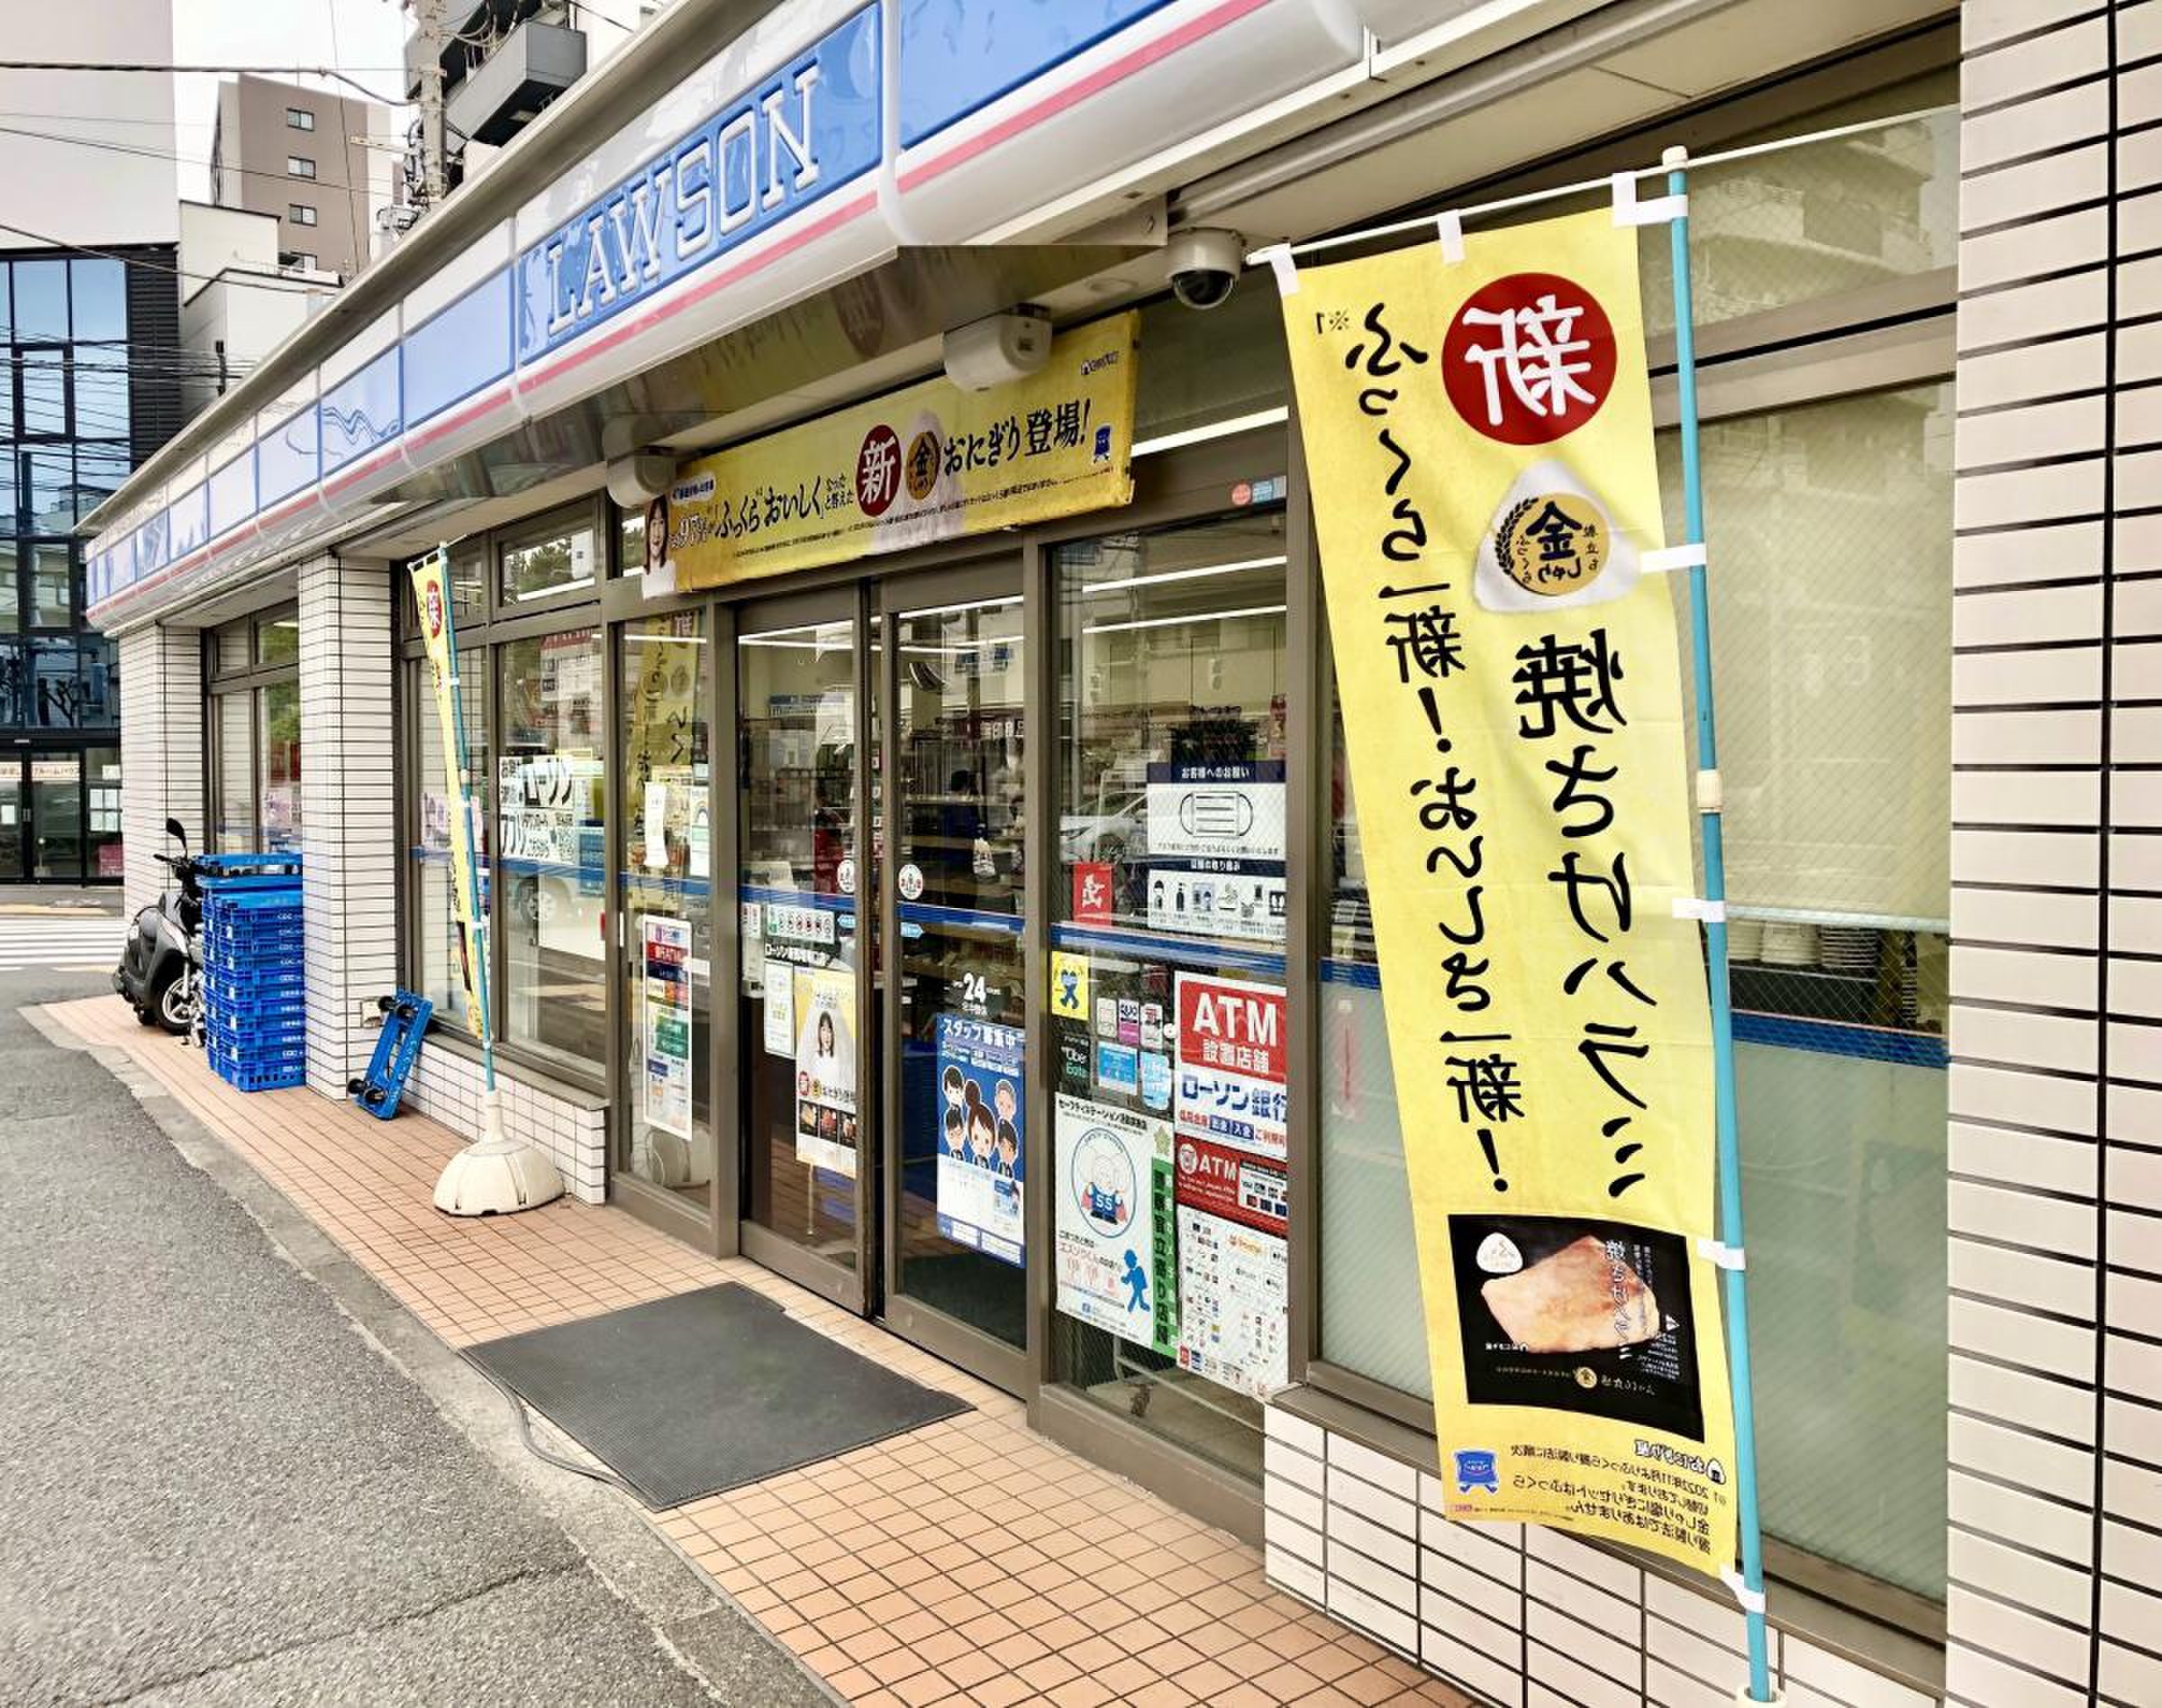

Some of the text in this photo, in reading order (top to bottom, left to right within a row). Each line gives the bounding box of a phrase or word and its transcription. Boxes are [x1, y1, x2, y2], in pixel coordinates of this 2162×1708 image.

[546, 59, 820, 337] LAWSON
[860, 436, 896, 504] 新
[964, 973, 986, 1004] 24
[1193, 992, 1277, 1047] ATM
[1203, 1039, 1269, 1075] 設置店舗
[1198, 1154, 1238, 1181] ATM
